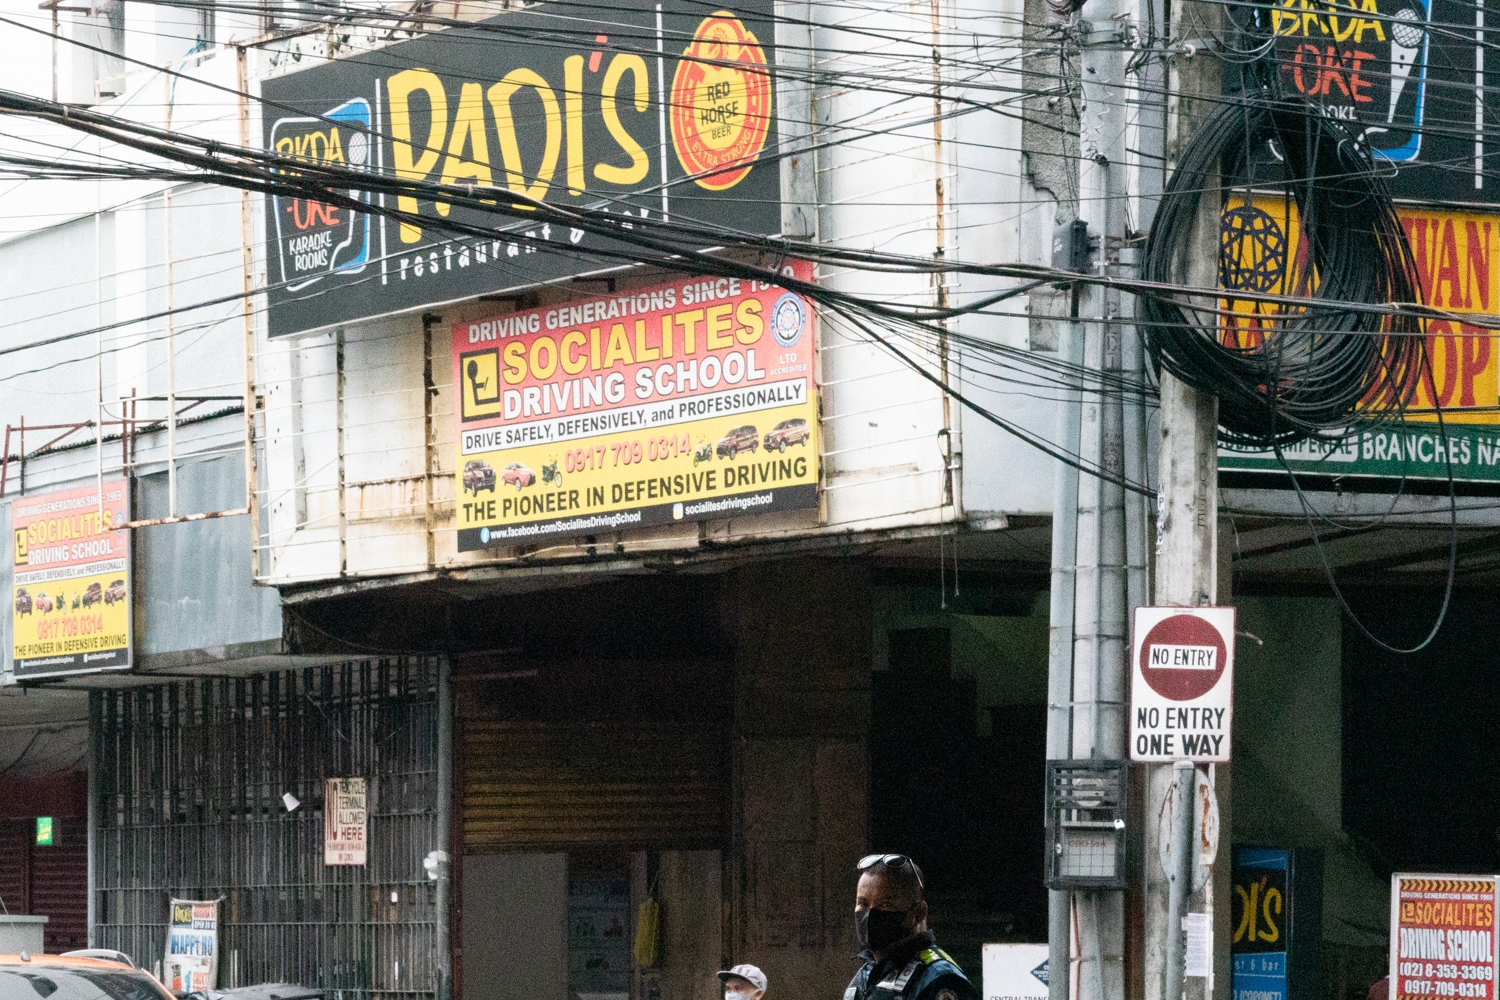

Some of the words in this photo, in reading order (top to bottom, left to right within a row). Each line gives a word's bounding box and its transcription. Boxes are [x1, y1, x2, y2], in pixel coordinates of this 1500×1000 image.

[707, 81, 730, 104] RED
[701, 101, 739, 127] HORSE
[386, 34, 650, 244] PADI'S
[711, 125, 732, 141] BEER
[692, 141, 719, 167] EXTRA
[721, 131, 752, 164] STRONG
[289, 231, 333, 256] KARAOKE
[295, 248, 329, 272] ROOMS
[468, 313, 541, 344] DRIVING
[545, 287, 677, 331] GENERATIONS
[682, 277, 742, 306] SINCE
[502, 297, 765, 386] SOCIALITES
[779, 352, 797, 365] LTO
[503, 371, 626, 421] DRIVING
[634, 348, 766, 400] SCHOOL
[465, 431, 502, 450] DRIVE
[505, 424, 554, 444] SAFELY,
[557, 409, 648, 437] DEFENSIVELY,
[651, 405, 675, 422] and
[679, 384, 803, 418] PROFESSIONALLY
[564, 444, 607, 474] 0917
[611, 439, 643, 467] 709
[647, 432, 692, 462] 0314
[1362, 432, 1472, 465] BRANCHES
[462, 500, 497, 523] THE
[502, 489, 581, 518] PIONEER
[586, 486, 605, 507] IN
[611, 469, 717, 505] DEFENSIVE
[724, 456, 808, 489] DRIVING
[28, 508, 113, 545] SOCIALITES
[28, 544, 69, 566] DRIVING
[71, 538, 114, 559] SCHOOL
[37, 618, 60, 641] 0917
[61, 616, 79, 638] 709
[80, 612, 104, 636] 0314
[15, 645, 27, 656] THE
[27, 642, 55, 655] PIONEER
[56, 641, 63, 652] IN
[64, 637, 99, 652] DEFENSIVE
[100, 633, 127, 649] DRIVING
[1152, 647, 1169, 665] NO
[1174, 648, 1215, 667] ENTRY
[1137, 707, 1160, 729] NO
[1165, 707, 1226, 730] ENTRY
[1136, 733, 1174, 756] ONE
[1181, 734, 1225, 757] WAY
[341, 826, 363, 841] HERE
[1415, 901, 1493, 927] SOCIALITES
[1400, 927, 1446, 961] DRIVING
[1447, 929, 1493, 963] SCHOOL
[1261, 957, 1280, 972] bar
[1400, 961, 1423, 977] (02)
[1425, 963, 1493, 981] 8-353-3369
[1404, 979, 1487, 998] 0917-709-0314
